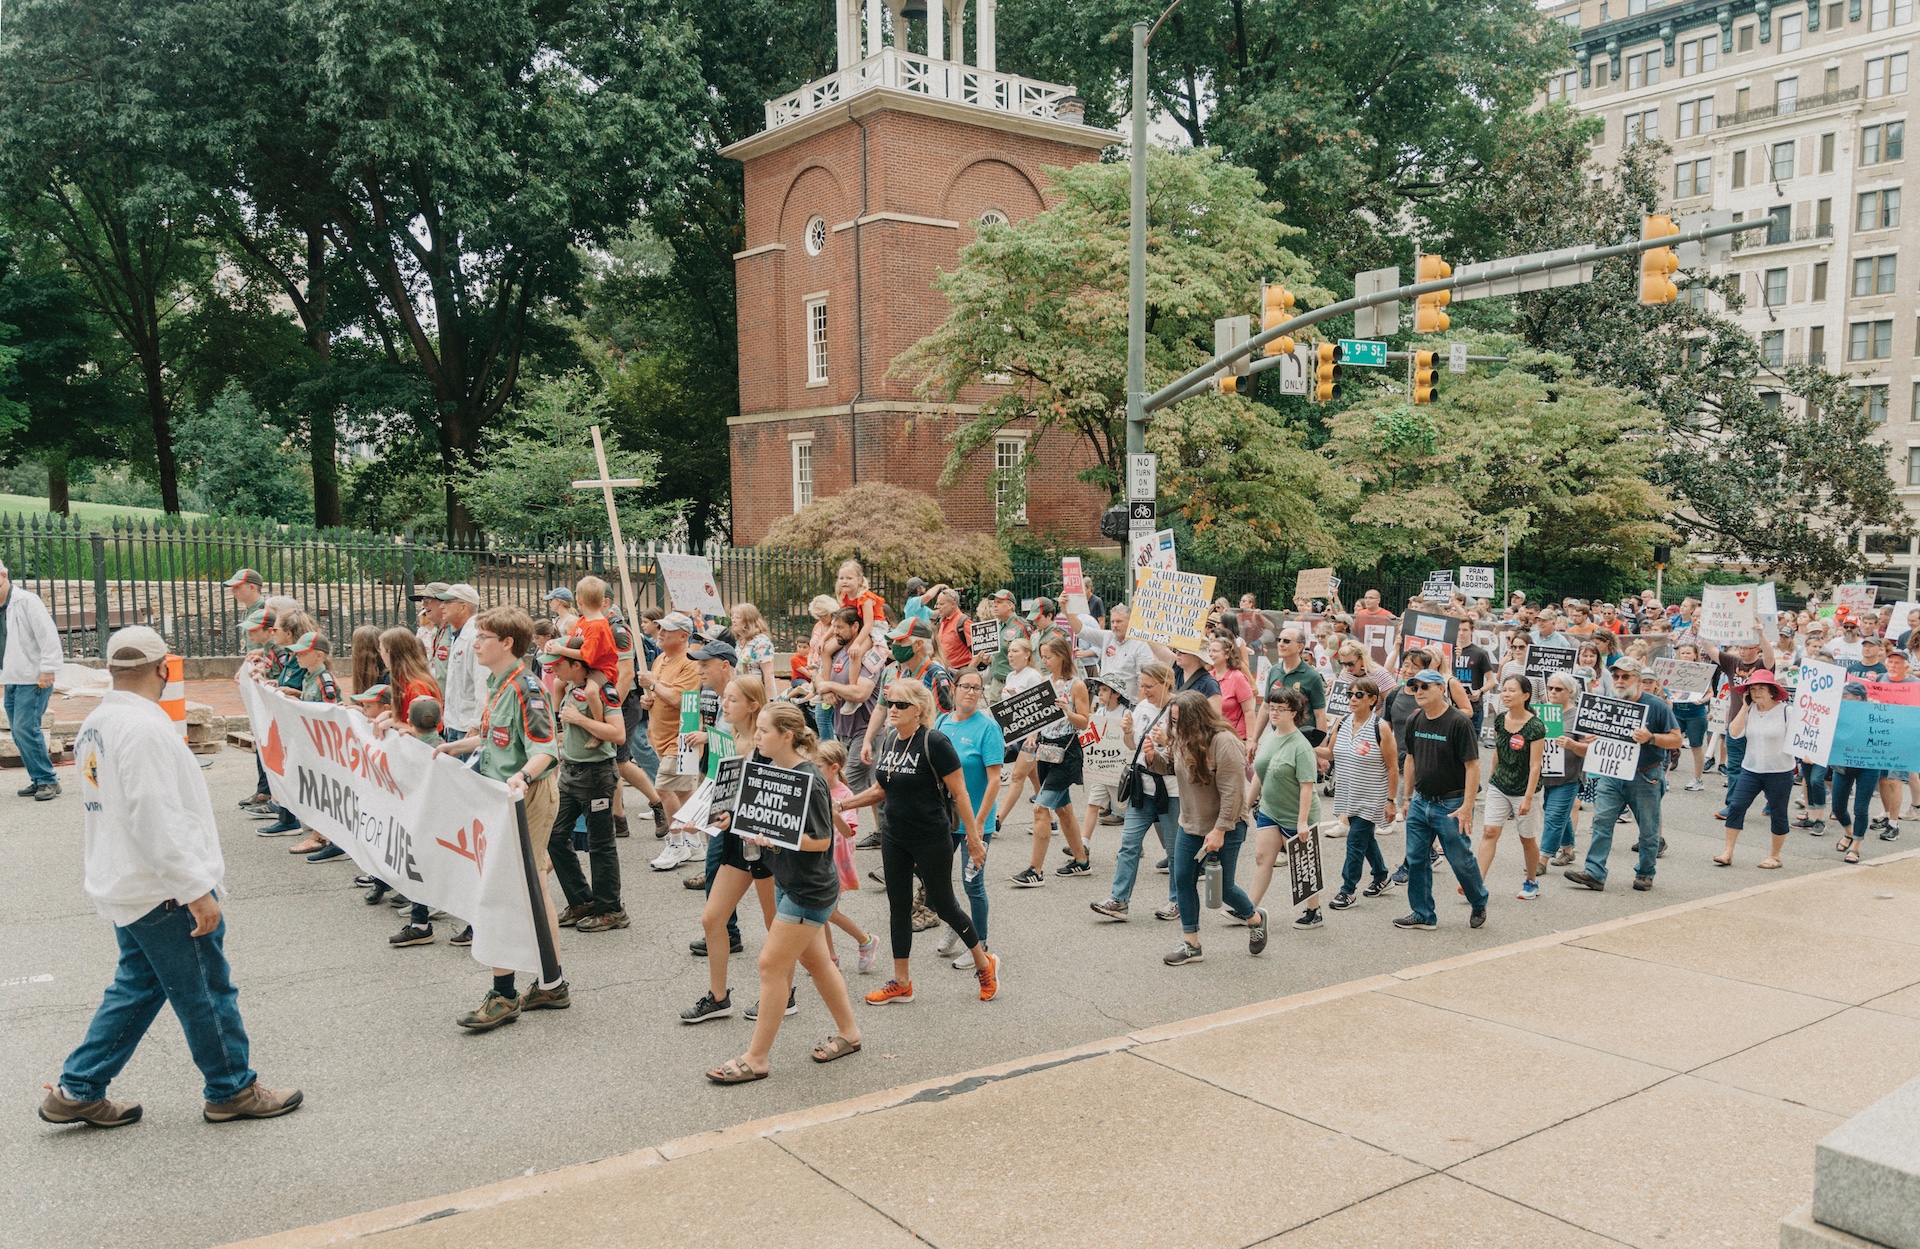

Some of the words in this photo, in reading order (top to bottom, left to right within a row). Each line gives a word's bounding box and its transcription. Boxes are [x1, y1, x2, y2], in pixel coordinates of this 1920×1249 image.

[1342, 343, 1351, 355] N.
[1355, 344, 1368, 355] 9th
[1371, 344, 1383, 357] St.
[1284, 380, 1304, 390] ONLY
[1138, 458, 1149, 466] NO
[1138, 488, 1148, 496] RED
[1146, 580, 1163, 590] ARE
[1171, 583, 1176, 592] A
[1180, 585, 1203, 597] GIFT
[1137, 598, 1154, 608] THE
[1157, 601, 1183, 614] FRUIT
[1188, 608, 1200, 619] OF
[1141, 608, 1158, 619] THE
[1164, 613, 1195, 627] WOMB
[1144, 621, 1150, 629] A
[986, 626, 996, 634] THE
[1129, 628, 1150, 639] Psalm
[1151, 632, 1171, 644] 127:3
[973, 632, 998, 645] PRO-LIFE
[974, 642, 998, 651] GENERATION
[1527, 664, 1572, 674] ABORTION
[1538, 658, 1563, 666] ANTI-
[1655, 660, 1676, 668] PRO
[1802, 666, 1818, 680] Pro
[1811, 675, 1833, 692] GOD
[682, 694, 697, 713] LIFE
[998, 707, 1013, 716] THE
[1013, 694, 1041, 710] FUTURE
[1042, 689, 1049, 697] IS
[1330, 693, 1349, 705] PRO
[1800, 694, 1830, 716] Choose
[1012, 702, 1043, 721] ANTI-
[1544, 706, 1561, 722] LIFE
[1593, 702, 1612, 712] AM
[1617, 706, 1640, 718] THE
[1003, 705, 1060, 736] ABORTION
[1579, 708, 1641, 729] PRO-LIFE
[1801, 710, 1820, 728] Life
[1868, 714, 1895, 724] Babies
[1803, 726, 1820, 740] Not
[1869, 727, 1890, 735] Lives
[708, 730, 723, 758] LOVE
[722, 736, 736, 758] LIFE
[1544, 739, 1559, 754] OSE
[1594, 740, 1634, 761] CHOOSE
[1793, 734, 1818, 753] Death
[1866, 739, 1892, 747] Matter
[883, 751, 920, 768] RUN
[1086, 746, 1121, 759] Jesus
[1088, 758, 1094, 766] is
[1600, 758, 1620, 776] LIFE
[722, 771, 730, 781] AM
[731, 769, 740, 779] THE
[762, 769, 780, 778] STUDENTS
[786, 774, 796, 782] LIFE
[714, 781, 738, 799] PRO-LIFE
[748, 777, 762, 789] THE
[763, 780, 792, 795] FUTURE
[794, 787, 802, 797] IS
[754, 791, 788, 808] ANTI-
[298, 765, 360, 840] MARCH
[360, 812, 384, 848] FOR
[385, 816, 423, 882] LIFE
[737, 804, 801, 831] ABORTION
[1294, 842, 1299, 851] IS
[1294, 852, 1302, 881] FUTURE
[1301, 850, 1310, 882] ANTI-
[1306, 830, 1318, 891] ABORTION
